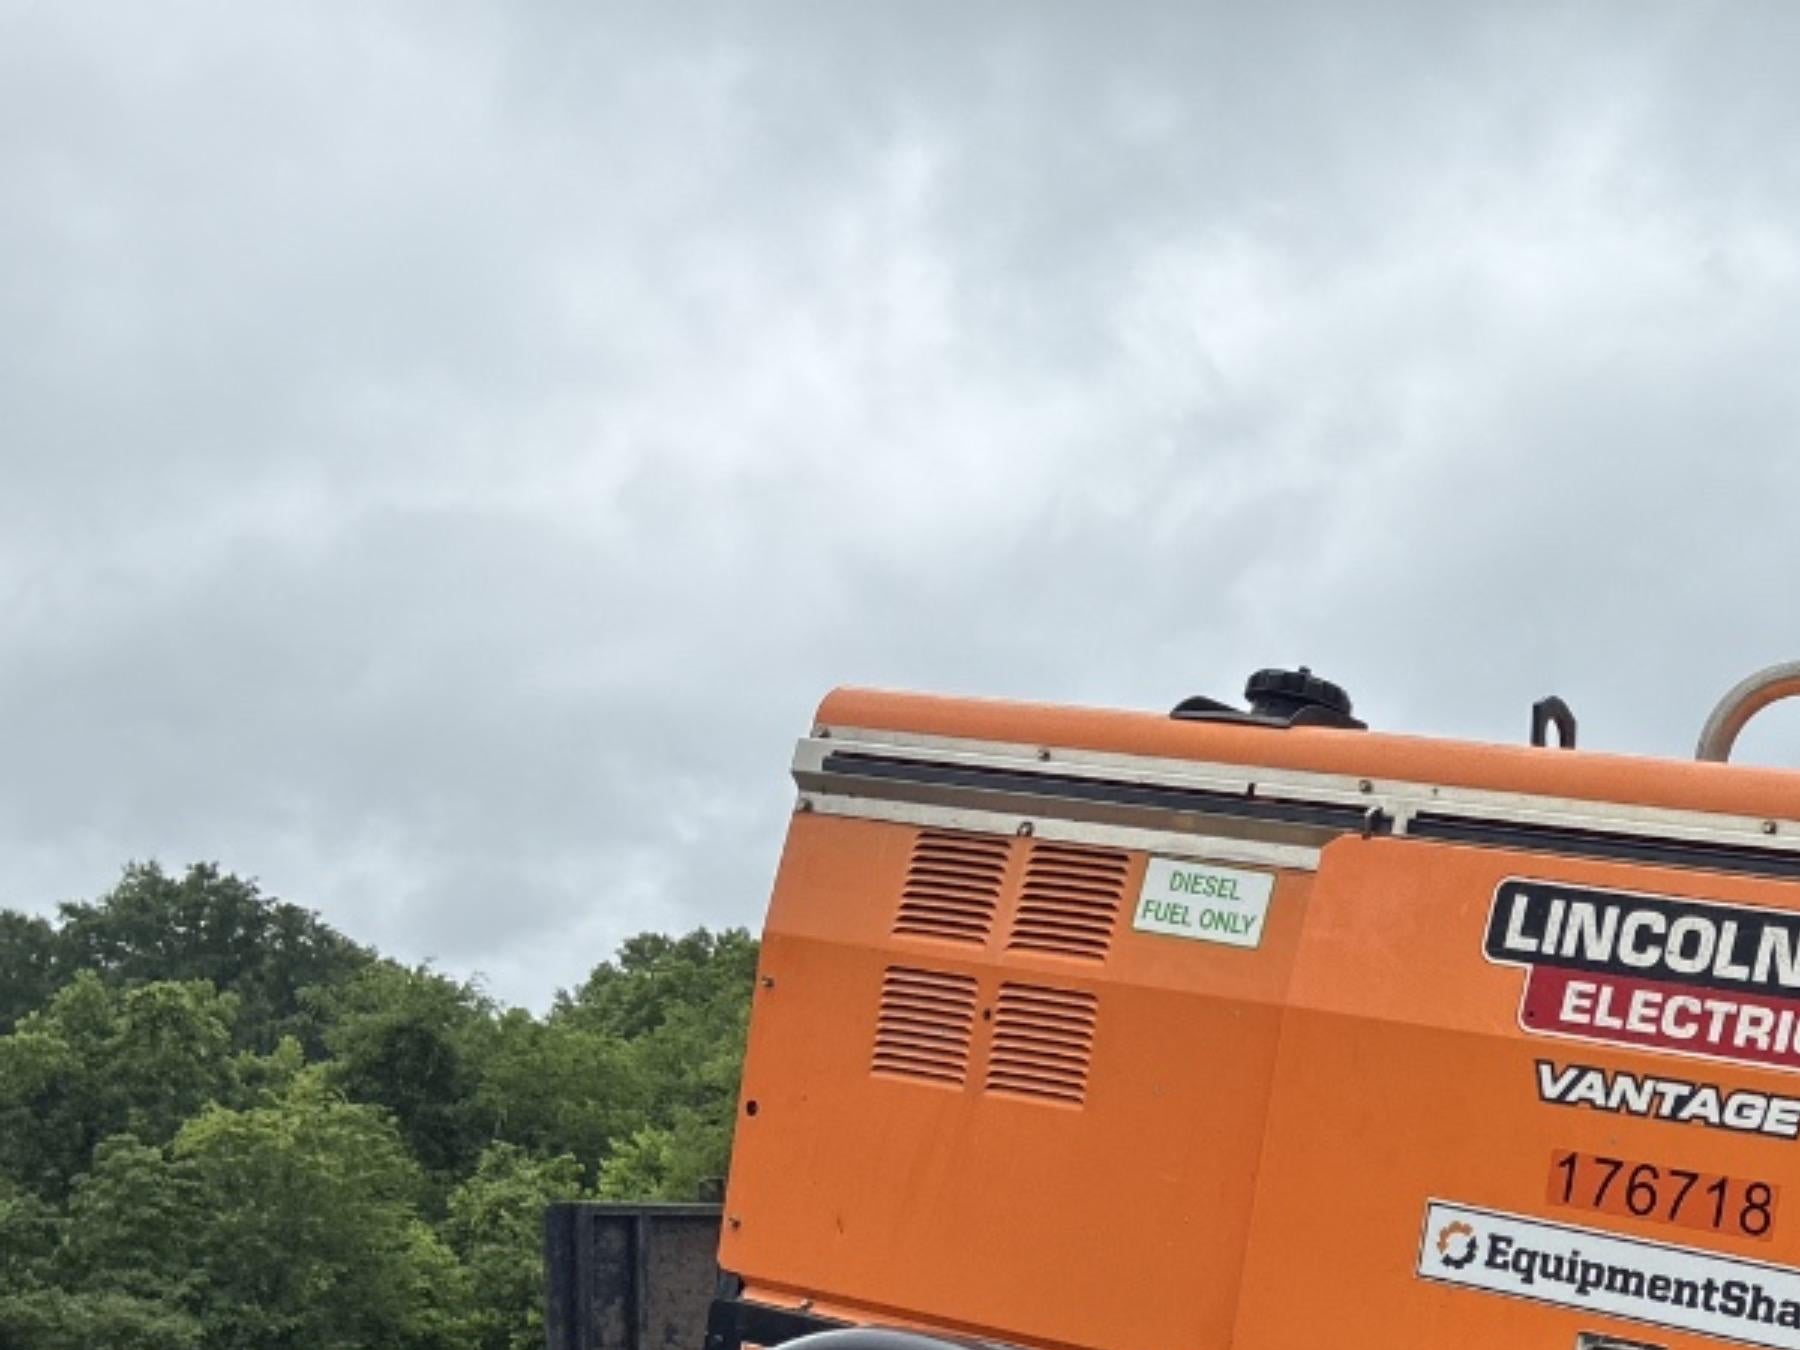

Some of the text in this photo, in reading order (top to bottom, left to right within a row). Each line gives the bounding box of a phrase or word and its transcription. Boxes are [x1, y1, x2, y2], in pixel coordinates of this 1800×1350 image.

[1169, 870, 1241, 901] DIESEL
[1141, 899, 1257, 935] FUEL ONLY
[1557, 1151, 1773, 1237] 176718
